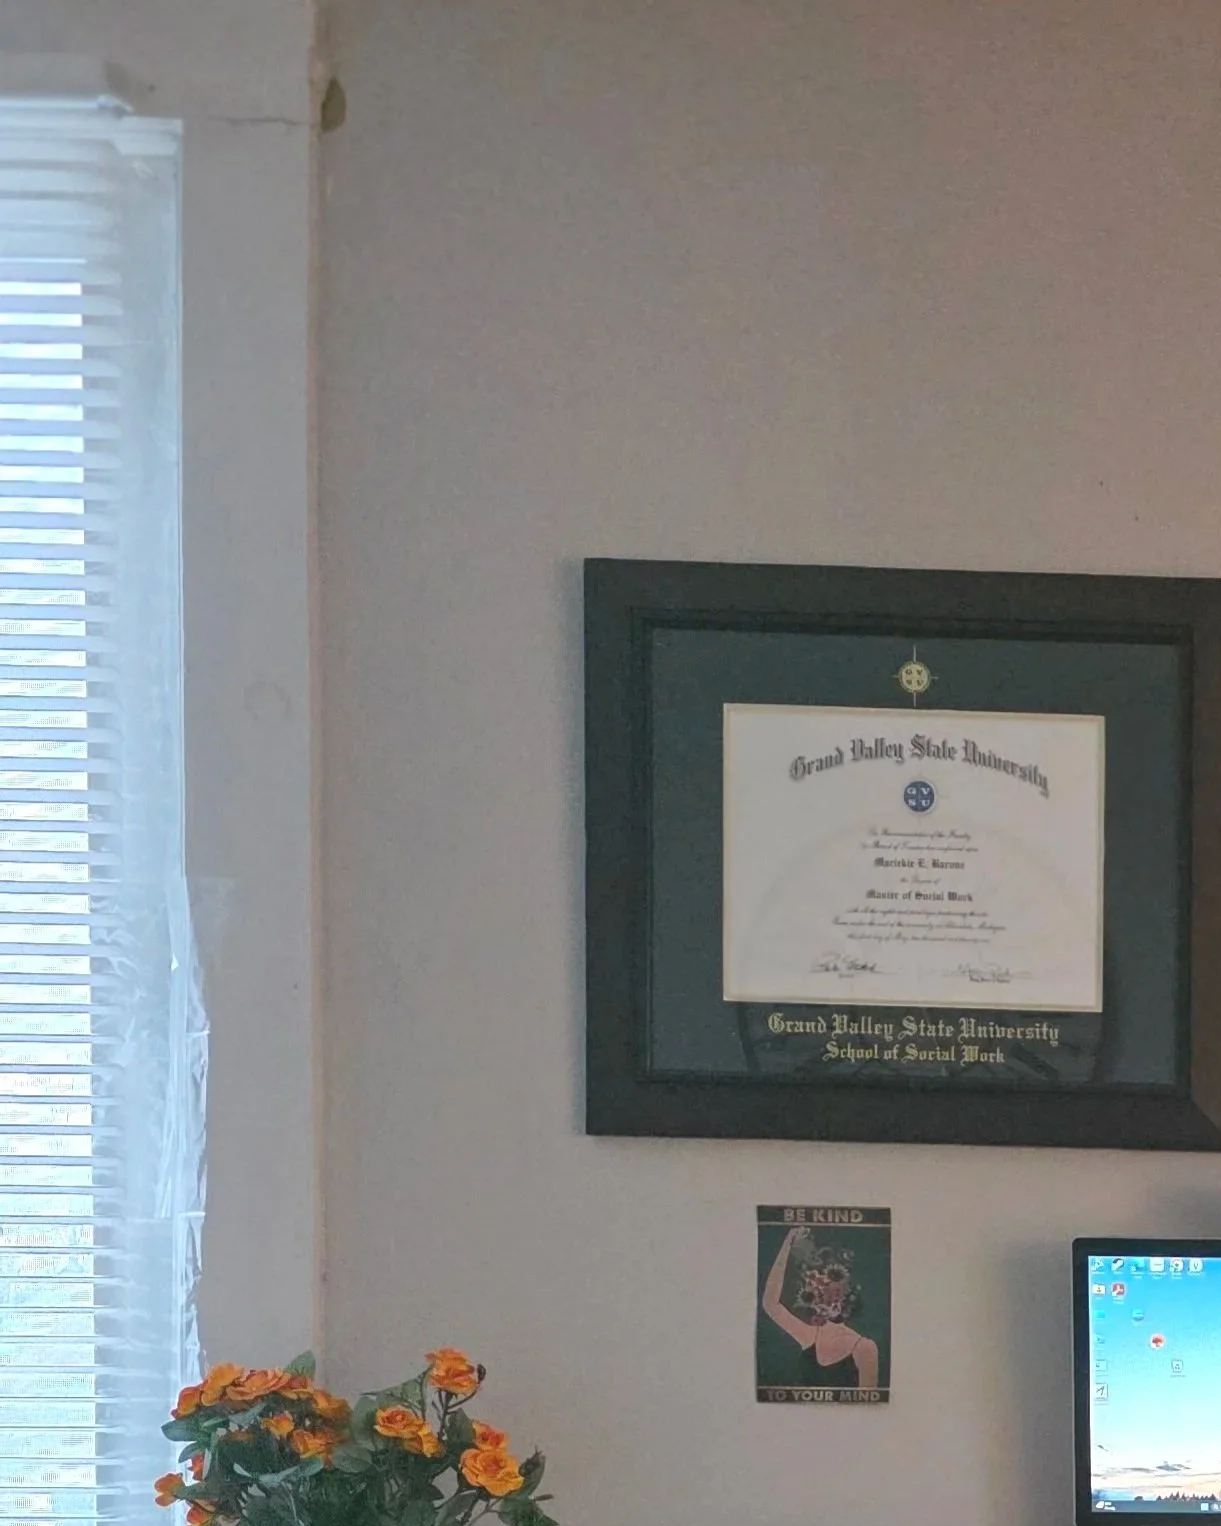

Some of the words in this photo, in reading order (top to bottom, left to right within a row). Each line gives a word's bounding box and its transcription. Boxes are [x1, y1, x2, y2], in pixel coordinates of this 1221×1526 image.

[789, 746, 844, 781] Grand
[850, 737, 905, 764] Valley
[909, 733, 957, 760] State
[961, 738, 1049, 799] University
[768, 1012, 827, 1033] Grand
[831, 1013, 894, 1042] Valley
[897, 1015, 955, 1040] State
[957, 1017, 1059, 1047] University
[822, 1040, 878, 1063] School
[883, 1043, 900, 1060] of
[901, 1043, 956, 1063] Social
[959, 1044, 1006, 1067] Work
[783, 1208, 806, 1223] BE
[812, 1208, 864, 1223] KIND
[766, 1389, 786, 1401] TO
[791, 1389, 833, 1401] YOUR
[839, 1390, 881, 1401] MIND
